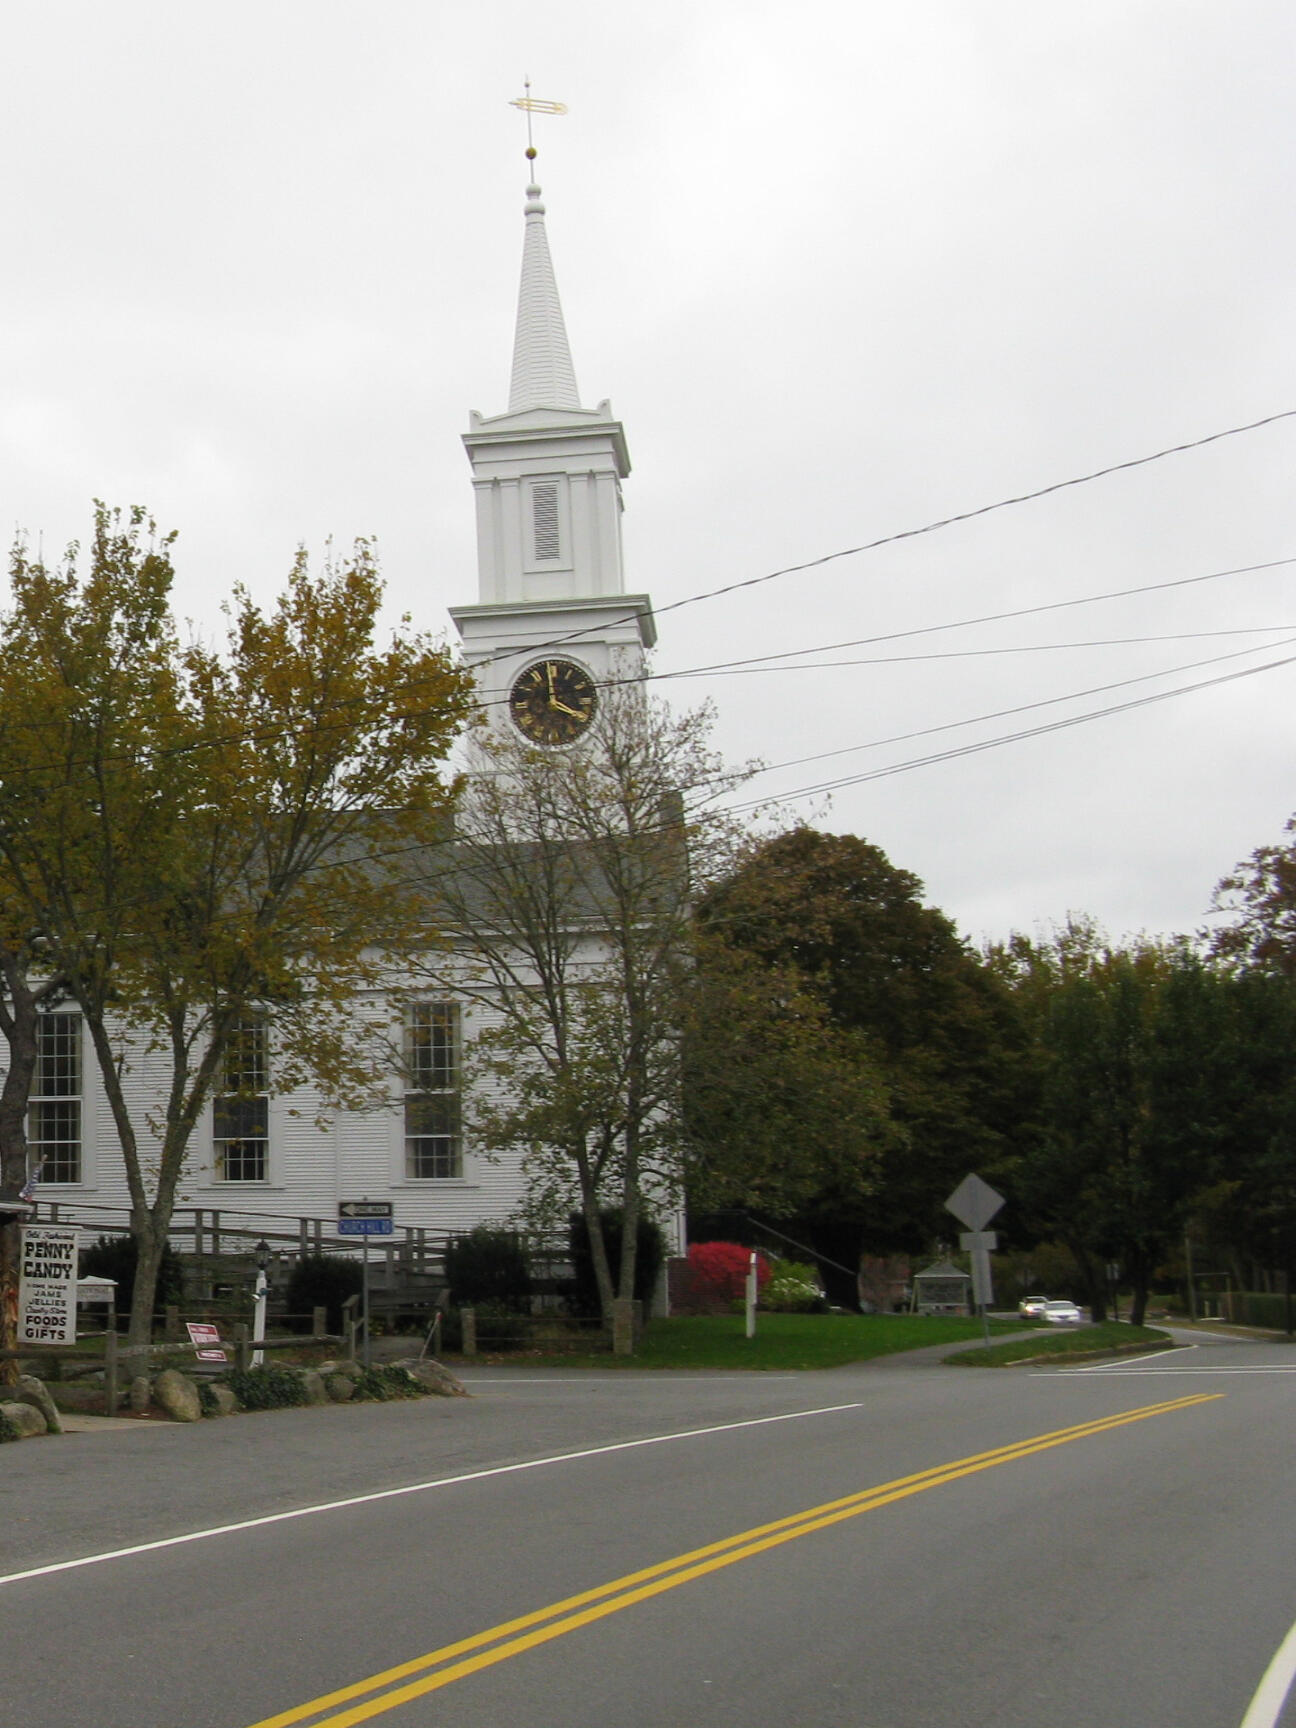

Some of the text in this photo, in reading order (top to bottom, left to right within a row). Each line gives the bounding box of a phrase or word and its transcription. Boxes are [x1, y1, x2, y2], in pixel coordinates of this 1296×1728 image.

[25, 1242, 74, 1260] PENNY
[24, 1261, 73, 1279] CANDY
[34, 1290, 61, 1298] JAMS
[29, 1298, 66, 1307] JELLIES
[26, 1316, 67, 1326] FOODS
[25, 1328, 65, 1340] GIFTS
